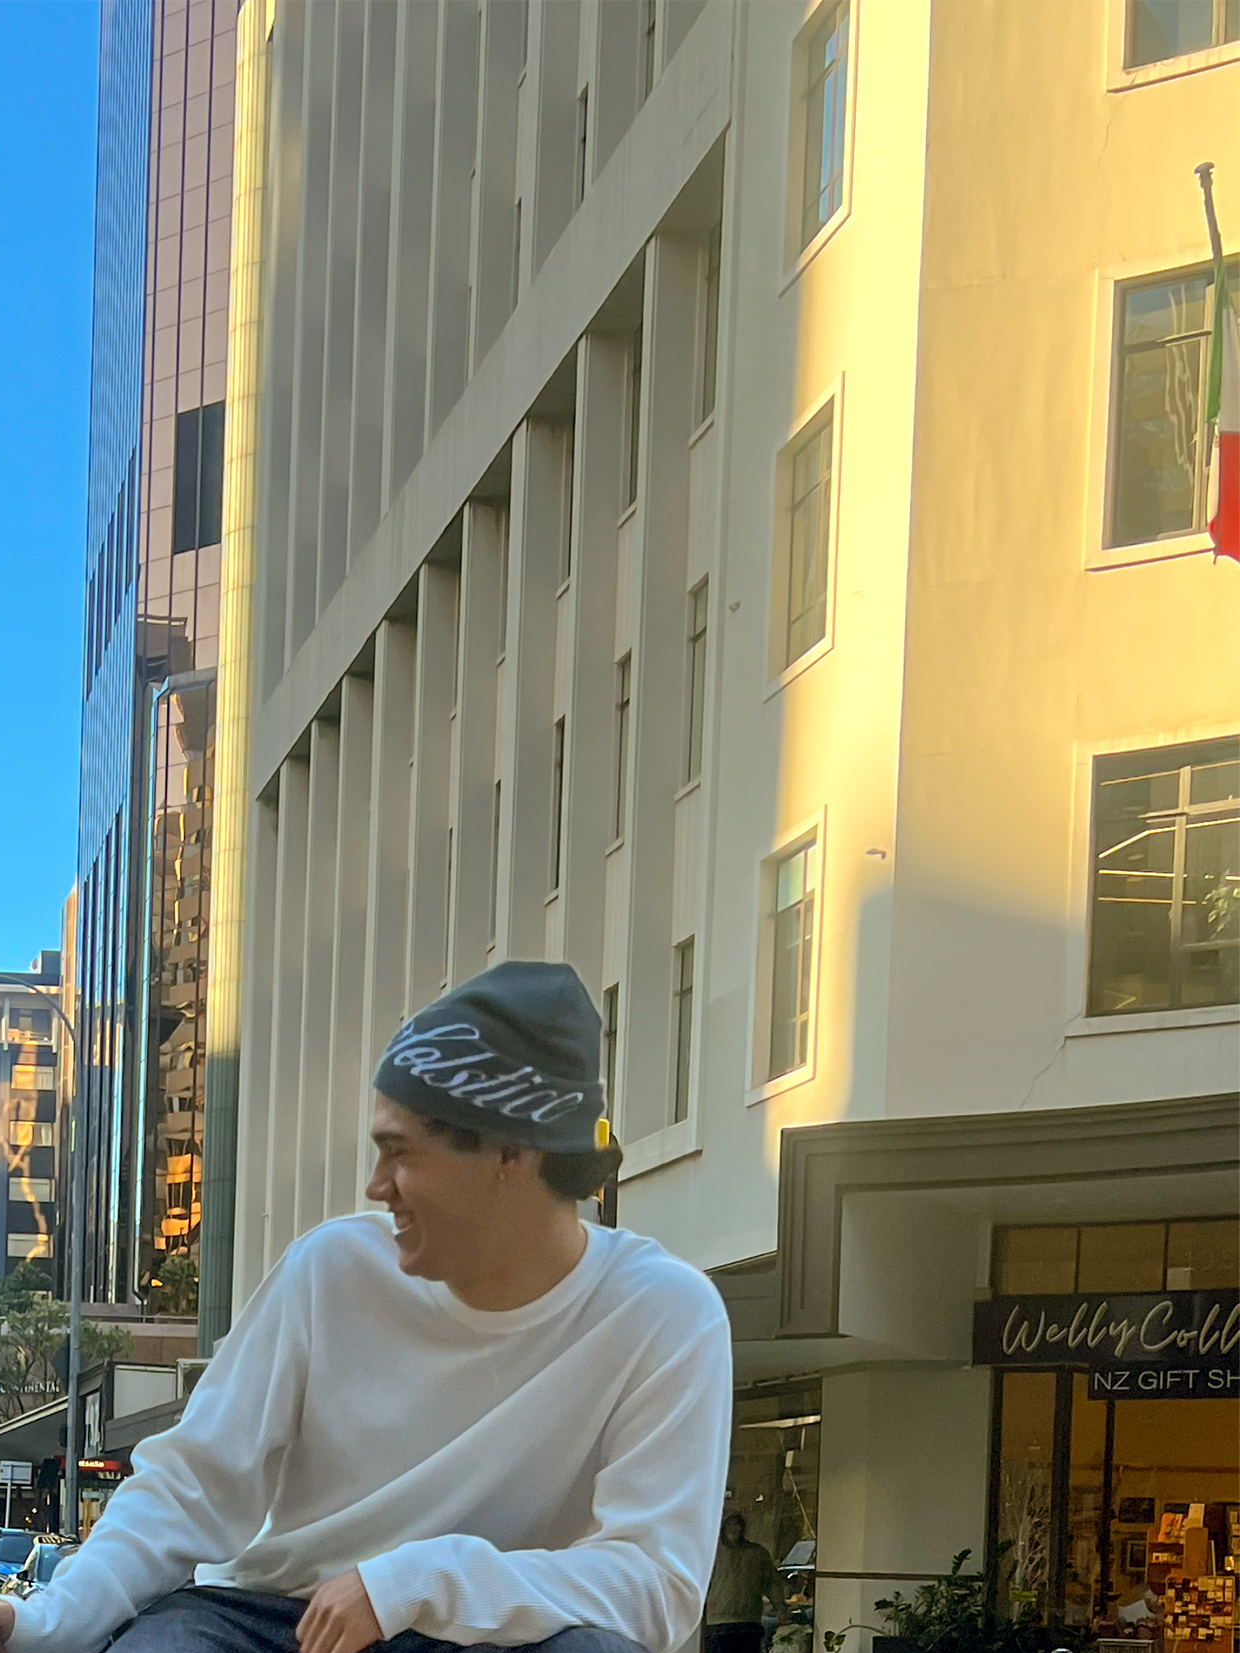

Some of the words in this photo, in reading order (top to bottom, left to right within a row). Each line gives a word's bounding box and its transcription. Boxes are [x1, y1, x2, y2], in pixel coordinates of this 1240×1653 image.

[1002, 1301, 1137, 1358] Welly
[1094, 1371, 1131, 1391] NZ
[1137, 1370, 1200, 1390] GIFT
